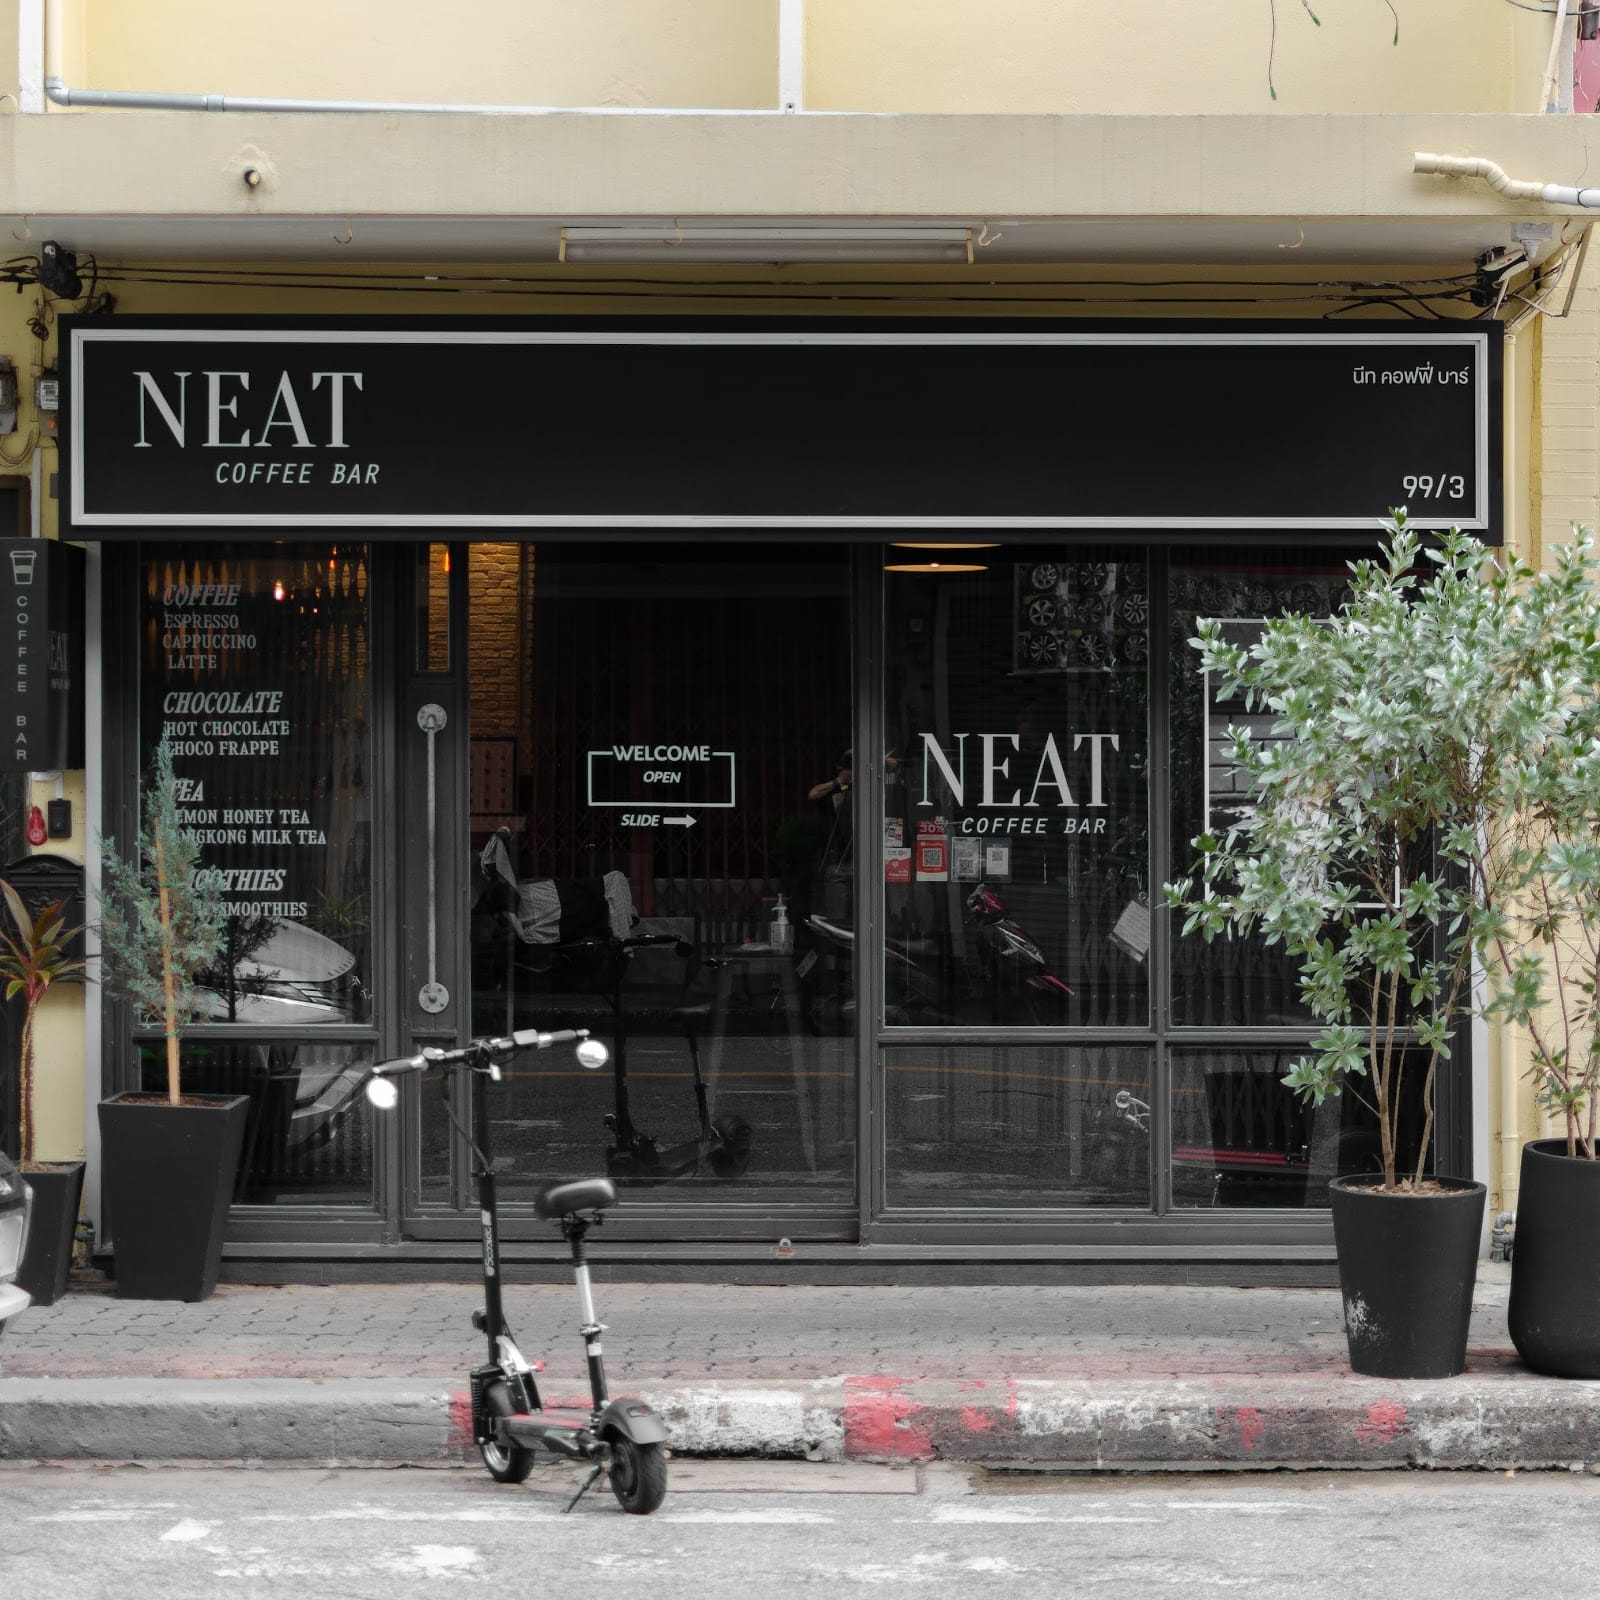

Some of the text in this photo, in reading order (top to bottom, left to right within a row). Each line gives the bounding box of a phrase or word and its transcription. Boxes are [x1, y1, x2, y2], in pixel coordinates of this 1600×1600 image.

[1353, 361, 1470, 384] นีท คอฟฟี่ บาร์
[132, 370, 363, 448] NEAT
[215, 462, 381, 484] COFFEE BAR
[1402, 474, 1465, 499] 99/3
[163, 584, 241, 606] COFFEE
[164, 614, 239, 629] ESPRESSO
[162, 634, 257, 649] CAPPUCCINO
[48, 629, 69, 671] EAT
[168, 654, 217, 669] LATTE
[16, 595, 29, 760] COFFEE BAR
[163, 691, 283, 714] CHOCOLATE
[166, 720, 290, 736] HOT CHOCOLATE
[219, 741, 279, 756] FRAPPE
[612, 745, 711, 761] WELCOME
[643, 771, 682, 783] OPEN
[916, 732, 1120, 807] NEAT
[175, 809, 310, 824] EMON HONEY TEA
[621, 814, 660, 827] SLIDE
[962, 817, 1106, 834] COFFEE BAR
[252, 829, 292, 845] MILK
[297, 829, 327, 845] TEA
[220, 902, 308, 917] SMOOTHIES
